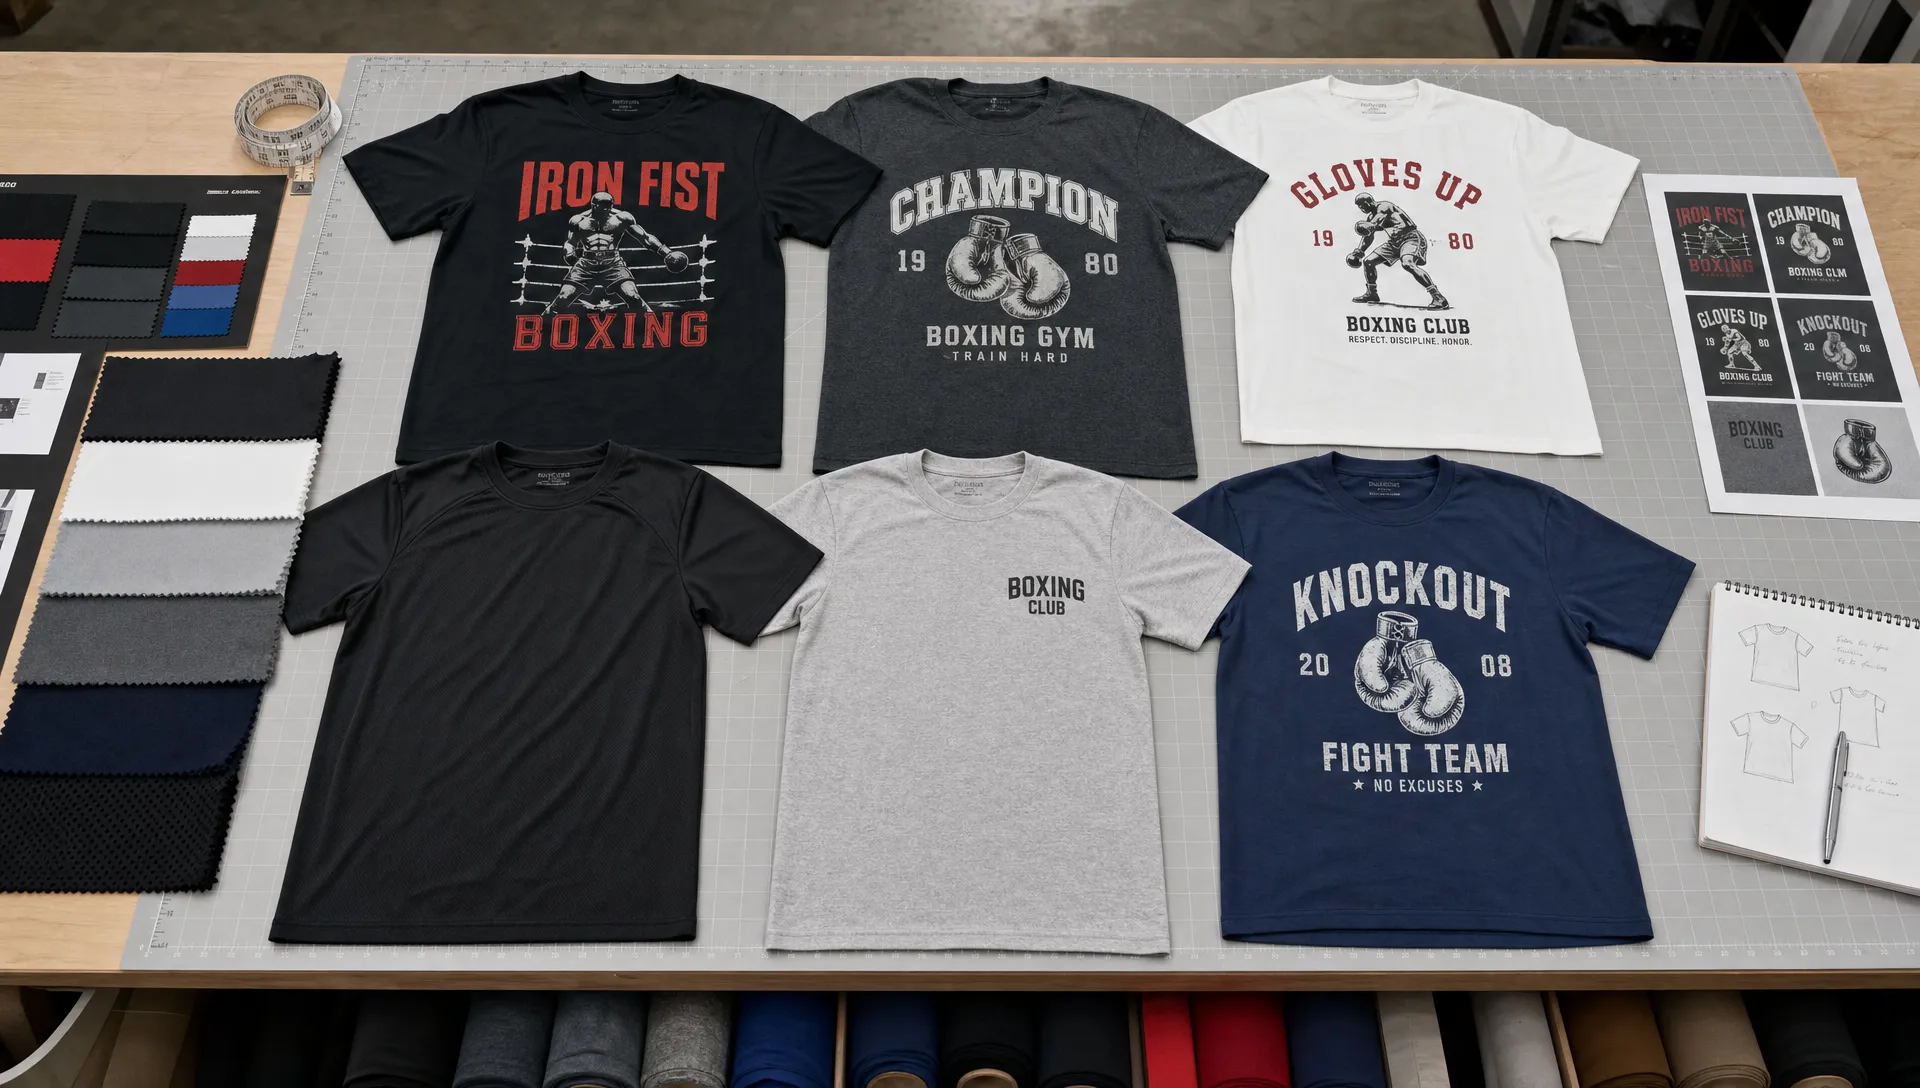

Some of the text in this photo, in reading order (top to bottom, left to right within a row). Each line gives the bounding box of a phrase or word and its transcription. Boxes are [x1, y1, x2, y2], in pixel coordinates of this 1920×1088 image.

[518, 161, 725, 222] IRON FIST
[1290, 158, 1482, 210] GLOVES UP
[890, 167, 1118, 243] CHAMPION
[1675, 206, 1745, 228] IRON FIST
[1767, 205, 1841, 231] CHAMPION
[1312, 229, 1474, 250] 19 80
[1775, 236, 1785, 245] 19
[898, 249, 1118, 276] 19 80
[1689, 258, 1754, 273] BOXING
[1788, 267, 1823, 277] BOXING
[1346, 316, 1470, 335] BOXING CLUB
[1697, 308, 1768, 330] GLOVES UP
[1797, 314, 1868, 337] KNOCKOUT
[513, 310, 709, 351] BOXING
[926, 324, 1095, 349] BOXING GYM
[1348, 335, 1473, 346] RESPECT. DISCIPLINE. HONOR.
[1705, 337, 1770, 347] 19 80
[1803, 342, 1871, 353] 20 08
[952, 351, 1068, 363] TRAIN HARD
[1719, 371, 1773, 382] BOXING CLUB
[1816, 371, 1875, 383] FIGHT TEAM
[1728, 420, 1784, 438] BOXING
[1743, 437, 1774, 450] CLUB
[1008, 575, 1085, 602] BOXING
[1293, 560, 1511, 633] KNOCKOUT
[1028, 599, 1066, 615] CLUB
[1299, 652, 1512, 677] 20 08
[1322, 741, 1510, 774] FIGHT TEAM
[1374, 779, 1463, 793] NO EXCUSES
